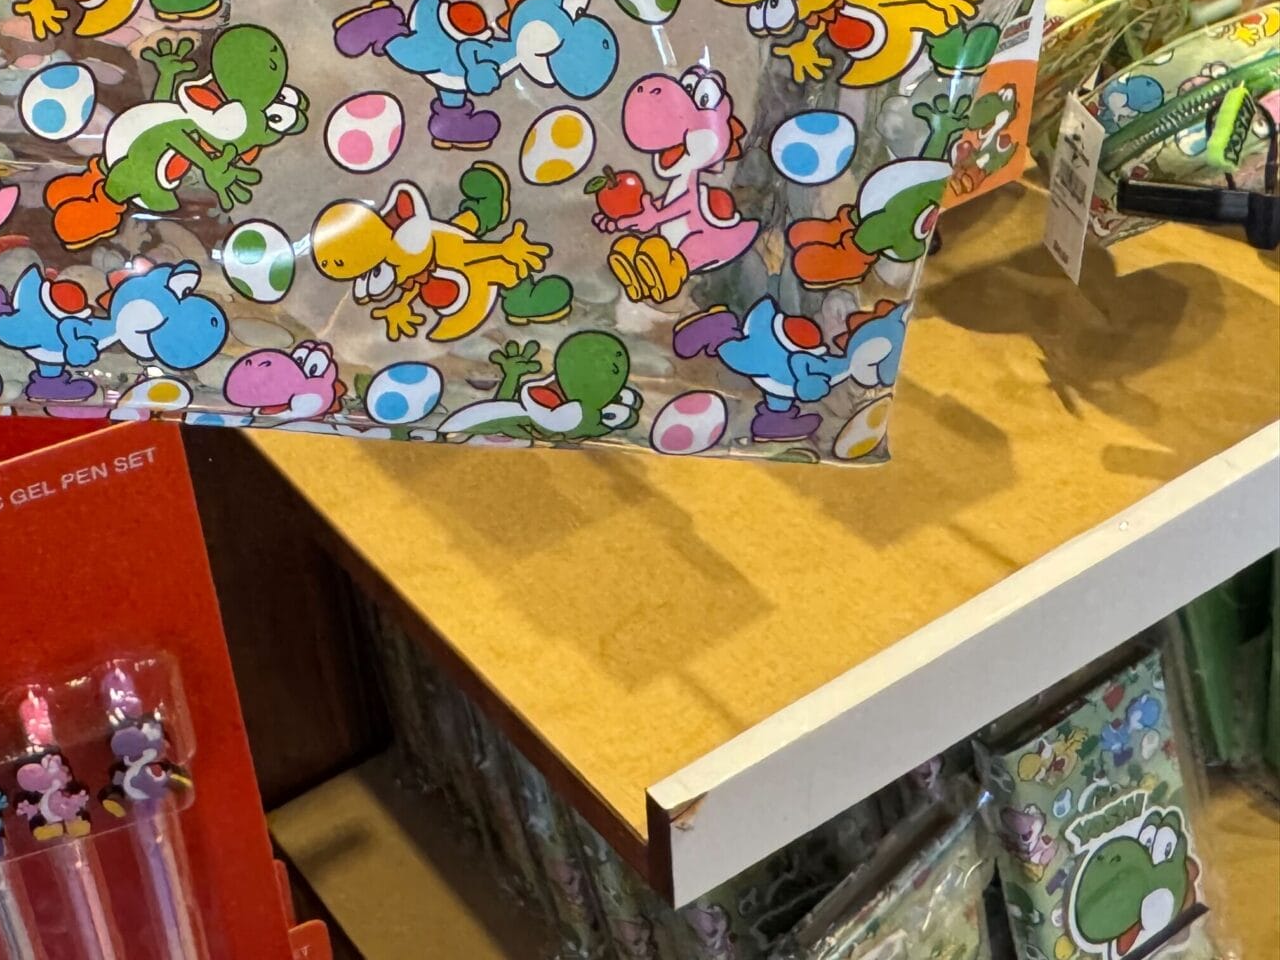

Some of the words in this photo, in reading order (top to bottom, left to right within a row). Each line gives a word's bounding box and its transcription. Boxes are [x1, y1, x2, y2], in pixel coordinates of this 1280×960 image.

[9, 480, 56, 505] GEL
[61, 462, 108, 490] PEN
[113, 446, 157, 472] SET
